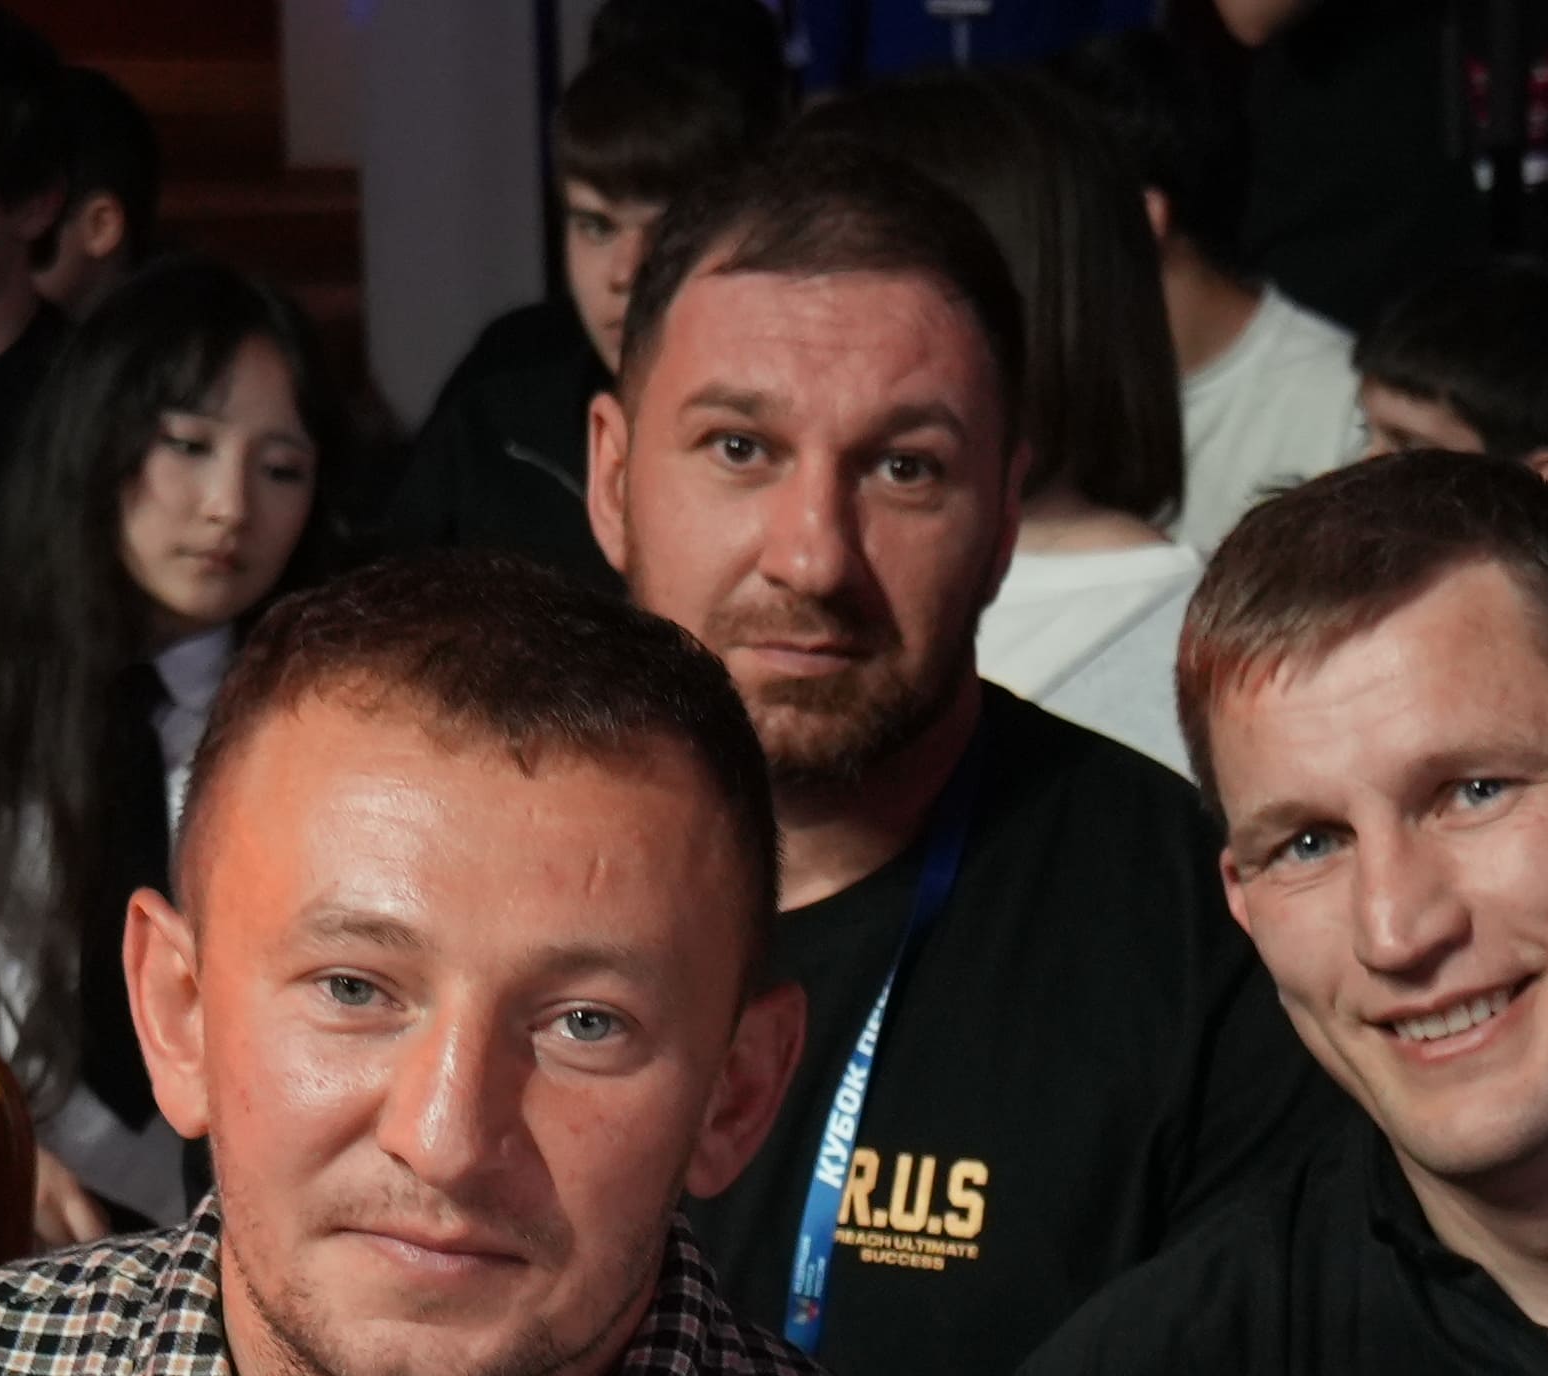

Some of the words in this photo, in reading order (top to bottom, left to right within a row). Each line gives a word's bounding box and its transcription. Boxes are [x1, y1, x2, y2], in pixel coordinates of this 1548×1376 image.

[816, 1060, 868, 1190] КУБОК
[838, 1147, 988, 1239] R.U.S
[861, 1250, 945, 1271] SUCCESS
[895, 1235, 979, 1260] ULTIMATE
